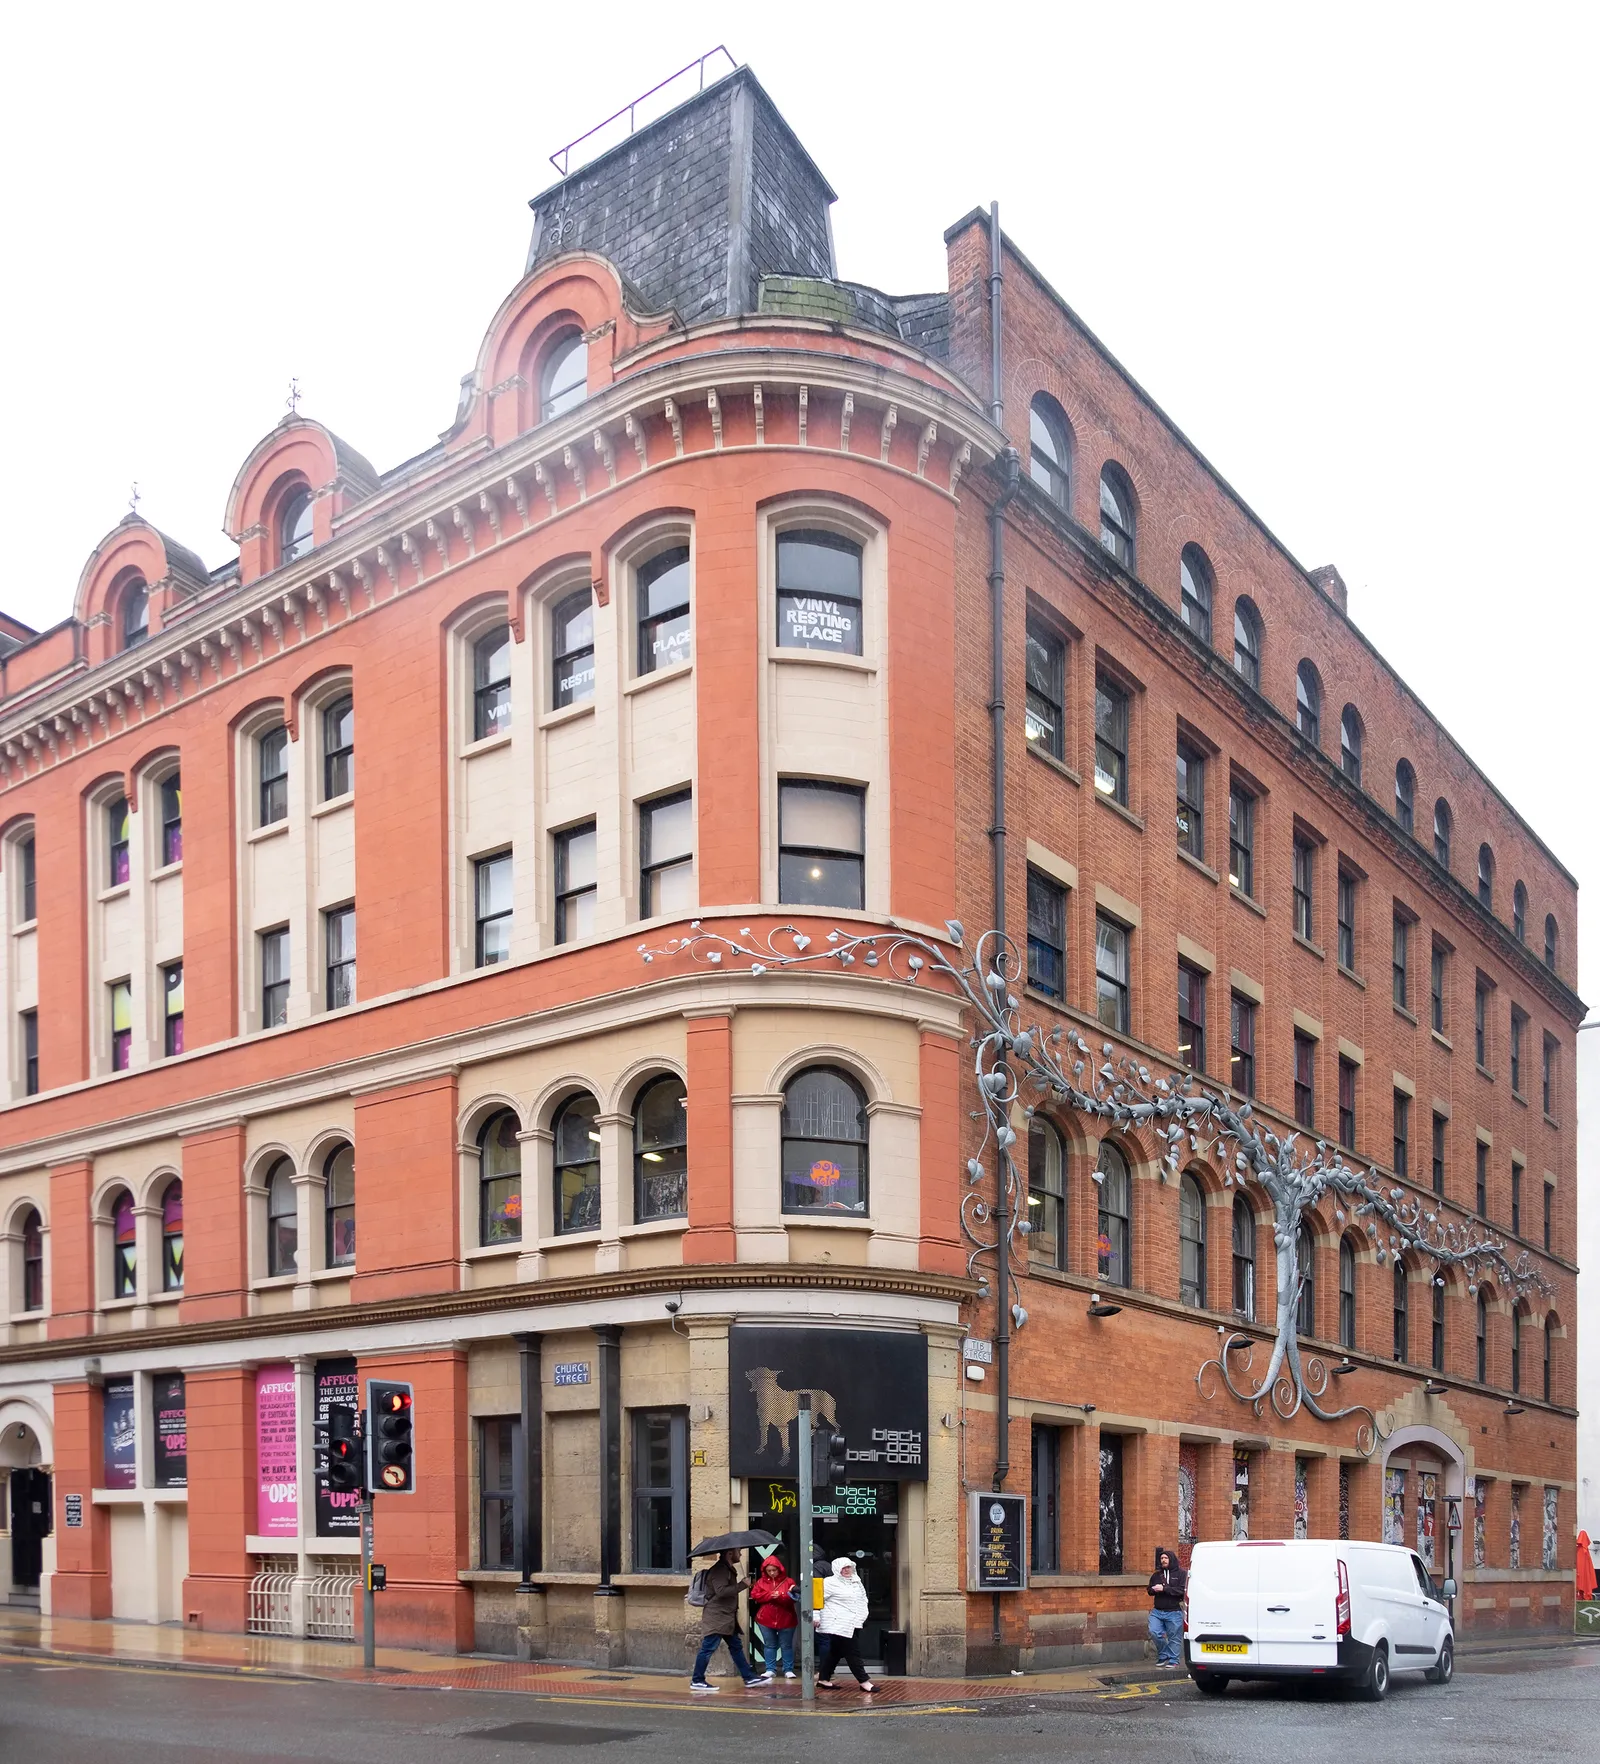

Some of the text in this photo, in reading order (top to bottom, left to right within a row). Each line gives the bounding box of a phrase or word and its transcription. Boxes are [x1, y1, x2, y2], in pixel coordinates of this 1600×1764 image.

[793, 597, 840, 615] VINYL
[786, 610, 852, 631] RESTING
[793, 624, 842, 643] PLACE
[971, 1340, 985, 1351] TIB
[964, 1349, 991, 1361] STREET
[555, 1363, 589, 1374] CHURCH
[555, 1373, 588, 1384] STREET
[320, 1387, 334, 1396] THE
[345, 1394, 354, 1402] OF
[872, 1428, 921, 1442] black
[846, 1449, 921, 1465] ballroom
[272, 1466, 286, 1474] HAVE
[836, 1486, 877, 1497] black
[812, 1505, 877, 1515] ballroom
[1205, 1643, 1243, 1653] HK19 OGX
